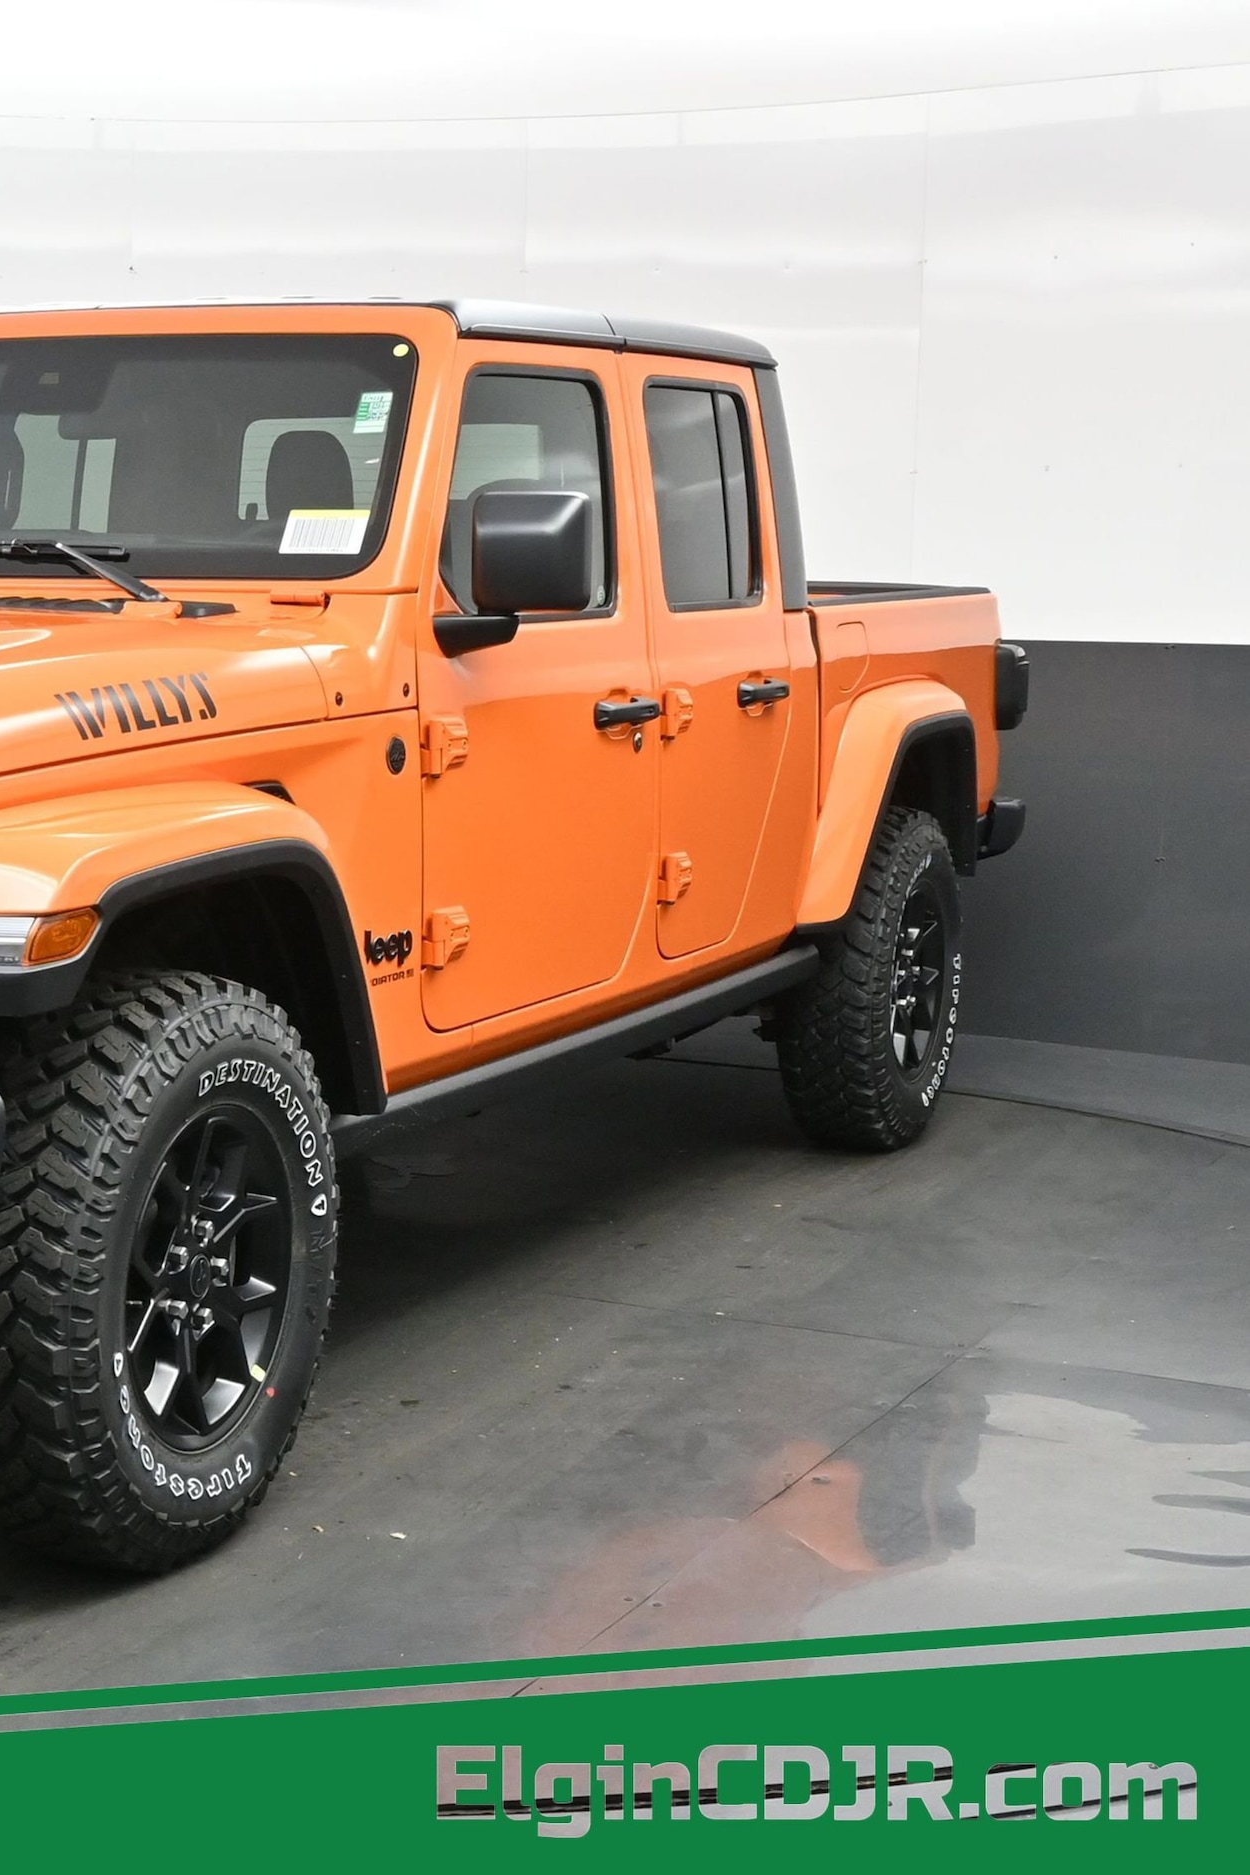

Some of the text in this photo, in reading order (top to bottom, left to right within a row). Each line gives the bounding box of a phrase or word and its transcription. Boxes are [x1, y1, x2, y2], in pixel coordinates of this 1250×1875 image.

[53, 672, 217, 740] WILLYS
[198, 1058, 325, 1187] DESTINATION
[119, 1385, 252, 1500] Firestone
